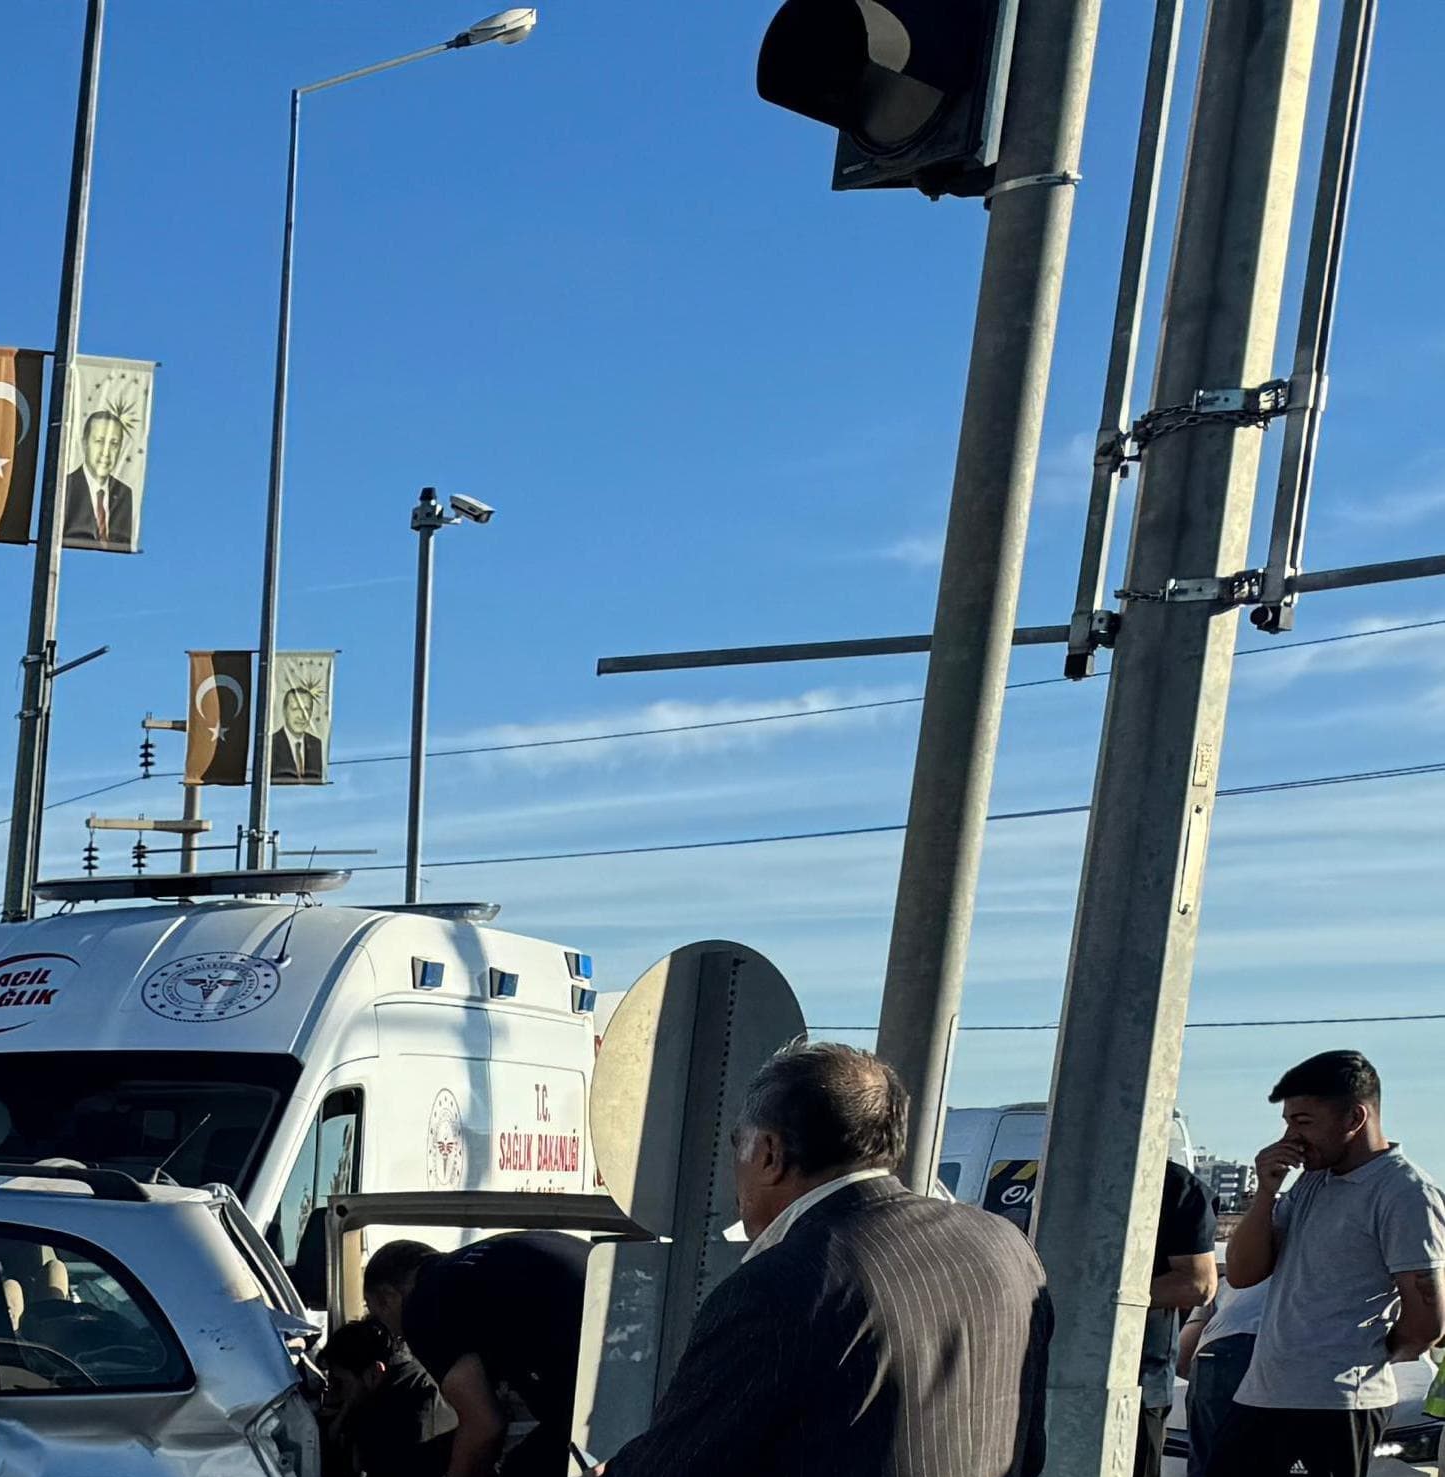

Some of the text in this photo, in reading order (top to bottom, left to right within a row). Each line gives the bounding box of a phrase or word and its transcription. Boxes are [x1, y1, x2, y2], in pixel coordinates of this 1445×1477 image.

[535, 1083, 551, 1122] T.C.
[499, 1125, 579, 1172] SAĞLIK BAKANLIĞI
